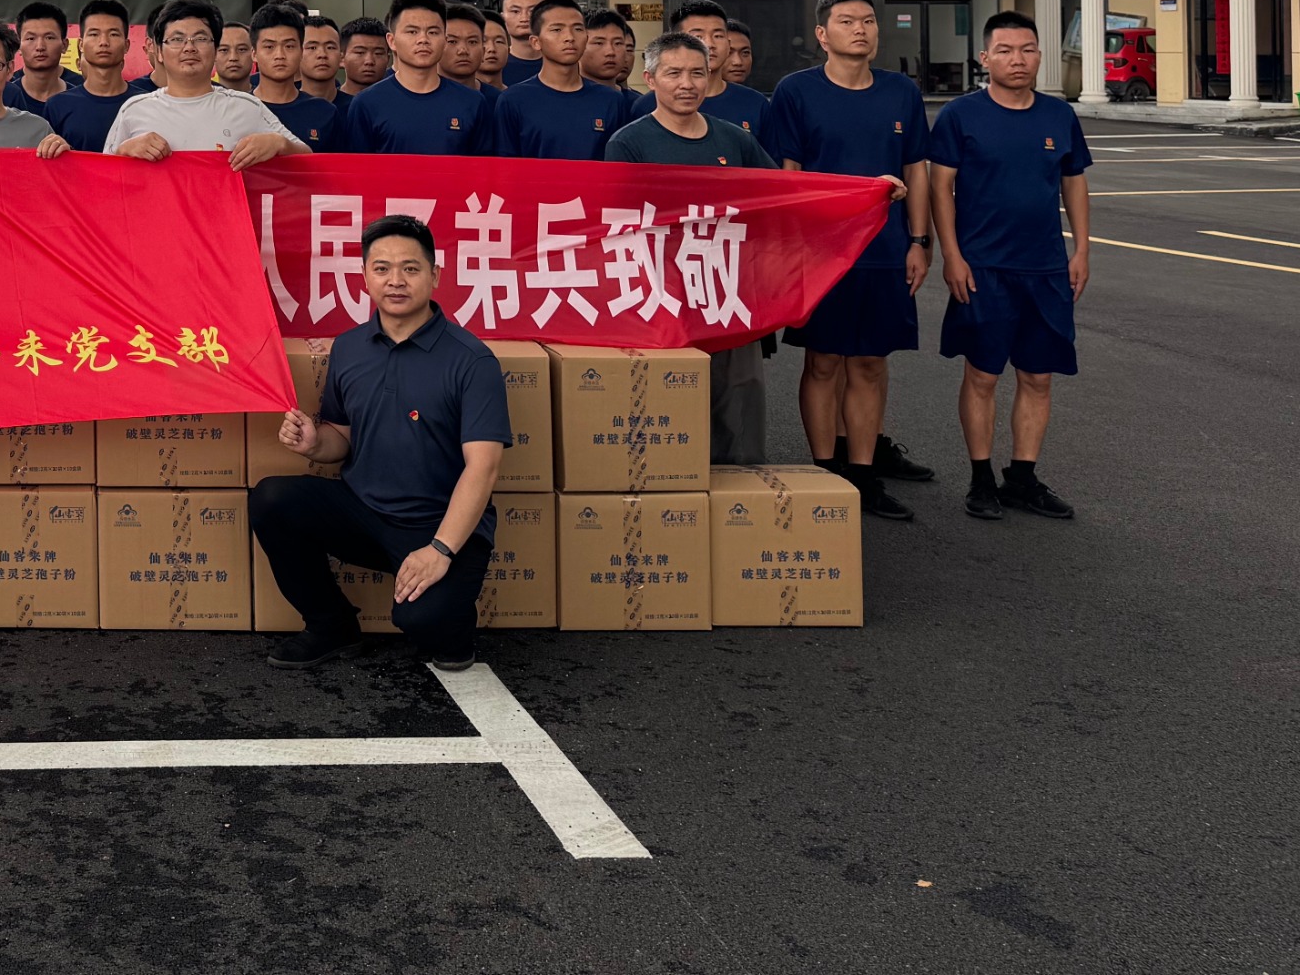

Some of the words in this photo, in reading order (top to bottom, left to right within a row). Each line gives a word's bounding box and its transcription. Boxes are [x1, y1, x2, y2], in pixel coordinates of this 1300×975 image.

[261, 192, 752, 329] 人民弟兵致敬
[125, 427, 223, 440] 破壁灵芝孢子粉
[761, 550, 821, 562] 仙客来牌
[741, 567, 841, 580] 破壁灵芝孢子粉
